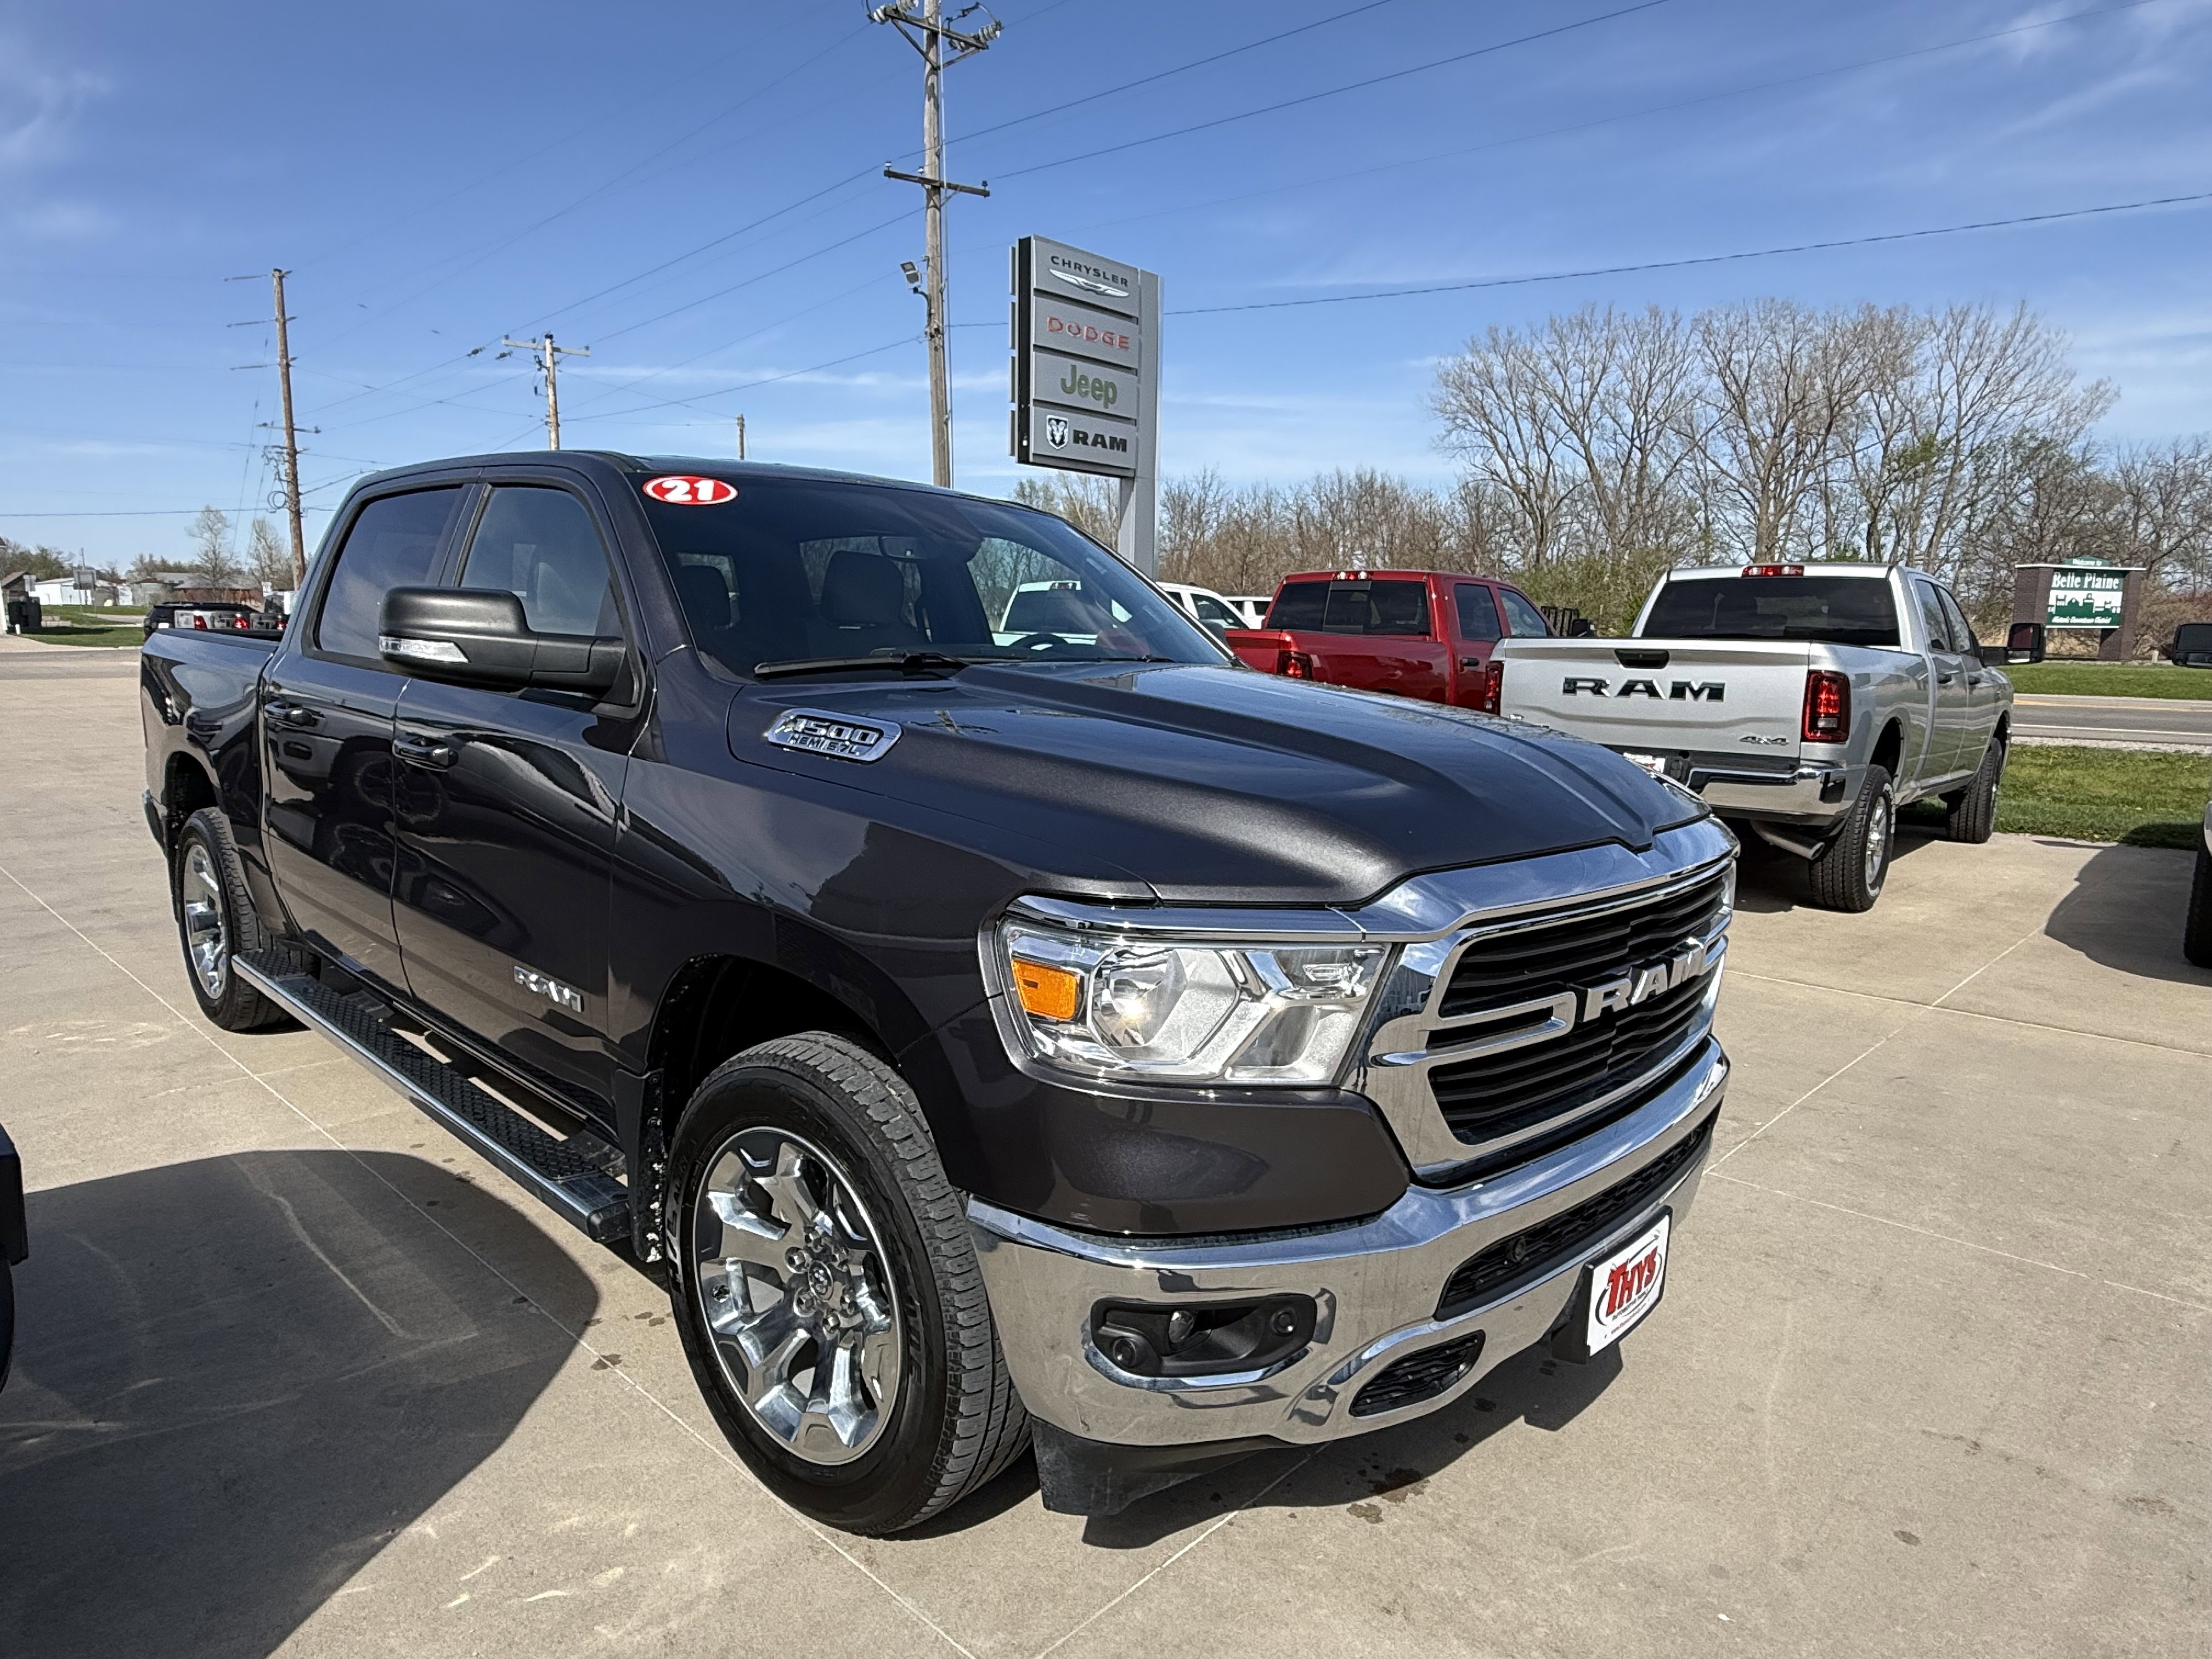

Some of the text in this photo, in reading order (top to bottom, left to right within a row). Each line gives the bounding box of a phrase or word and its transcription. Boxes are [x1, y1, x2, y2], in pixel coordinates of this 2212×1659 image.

[1050, 255, 1128, 287] CHRYSLER
[1047, 316, 1130, 351] DODGE
[1060, 364, 1118, 409] Jeep
[1073, 429, 1127, 453] RAM
[662, 479, 714, 501] 21
[2051, 572, 2120, 589] Belle Plaine
[1562, 676, 1726, 702] RAM
[788, 732, 823, 751] HEMI
[795, 718, 879, 745] 1500
[514, 966, 584, 1013] RAM
[1581, 938, 1704, 1023] RAM
[1605, 1245, 1658, 1318] THYS
